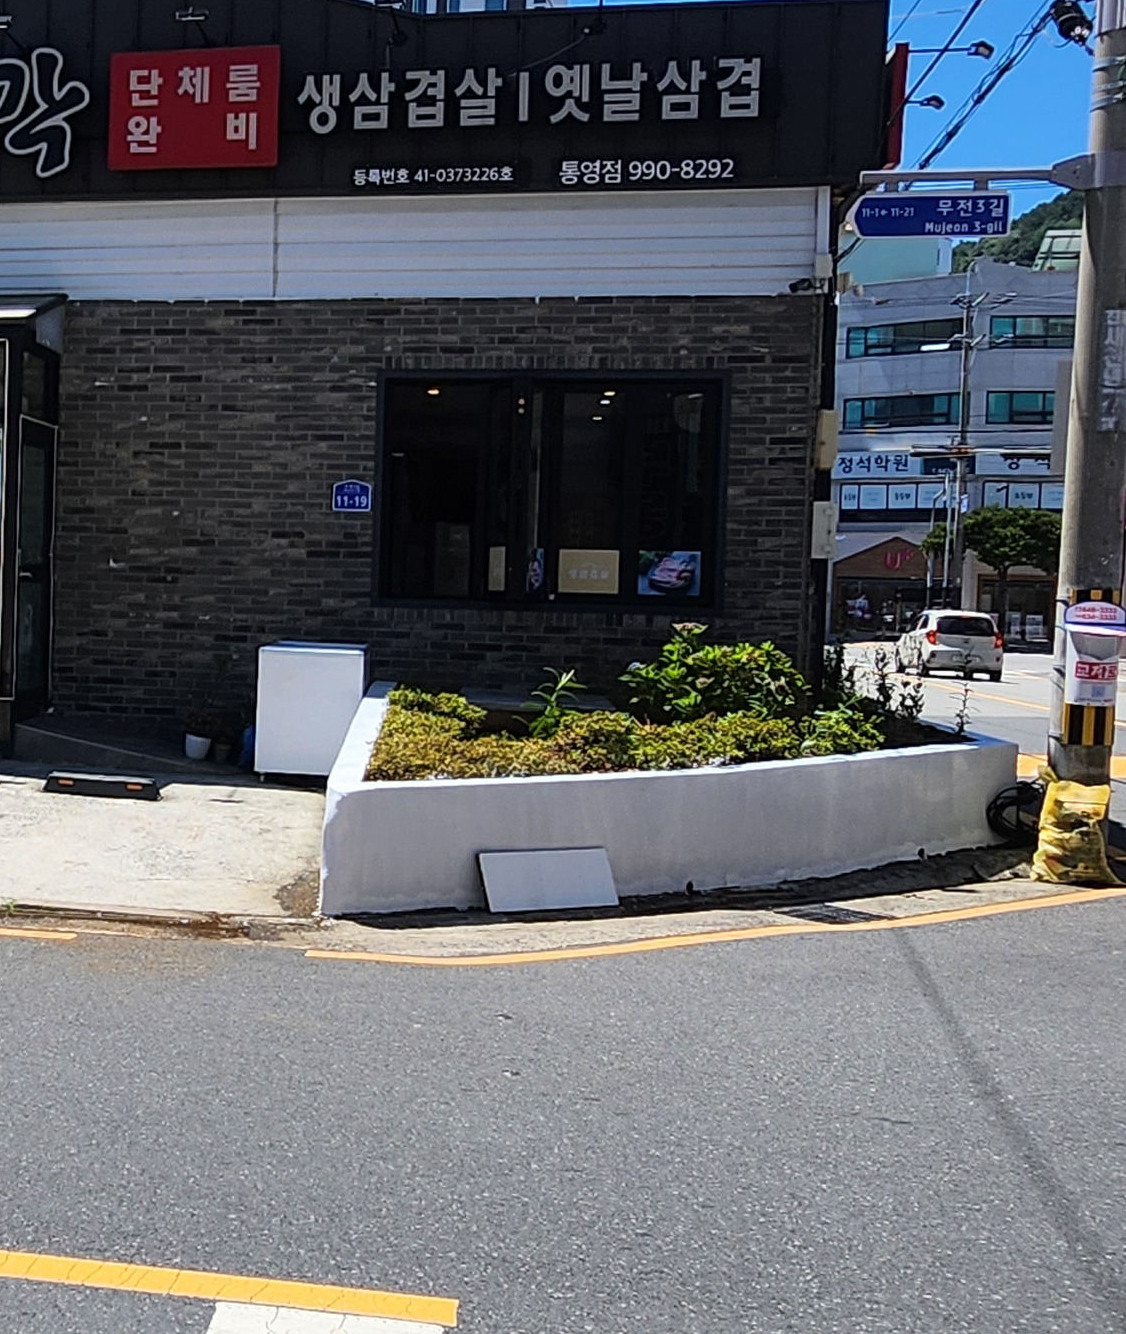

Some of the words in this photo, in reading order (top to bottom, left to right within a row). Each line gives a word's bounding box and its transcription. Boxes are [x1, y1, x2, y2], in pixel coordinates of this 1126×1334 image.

[129, 64, 262, 107] 단체룸
[296, 66, 503, 135] 생삼겹살
[544, 56, 763, 125] 옛날삼겹
[352, 168, 411, 186] 등록번호
[413, 166, 515, 183] 41-0373226호
[558, 160, 622, 185] 통영점
[627, 157, 736, 181] 990-8292
[935, 199, 1005, 218] 무전3길
[925, 221, 969, 235] Mujeon
[972, 221, 1004, 235] 3-gil
[837, 454, 910, 474] 정석학원
[336, 495, 368, 507] 11-19
